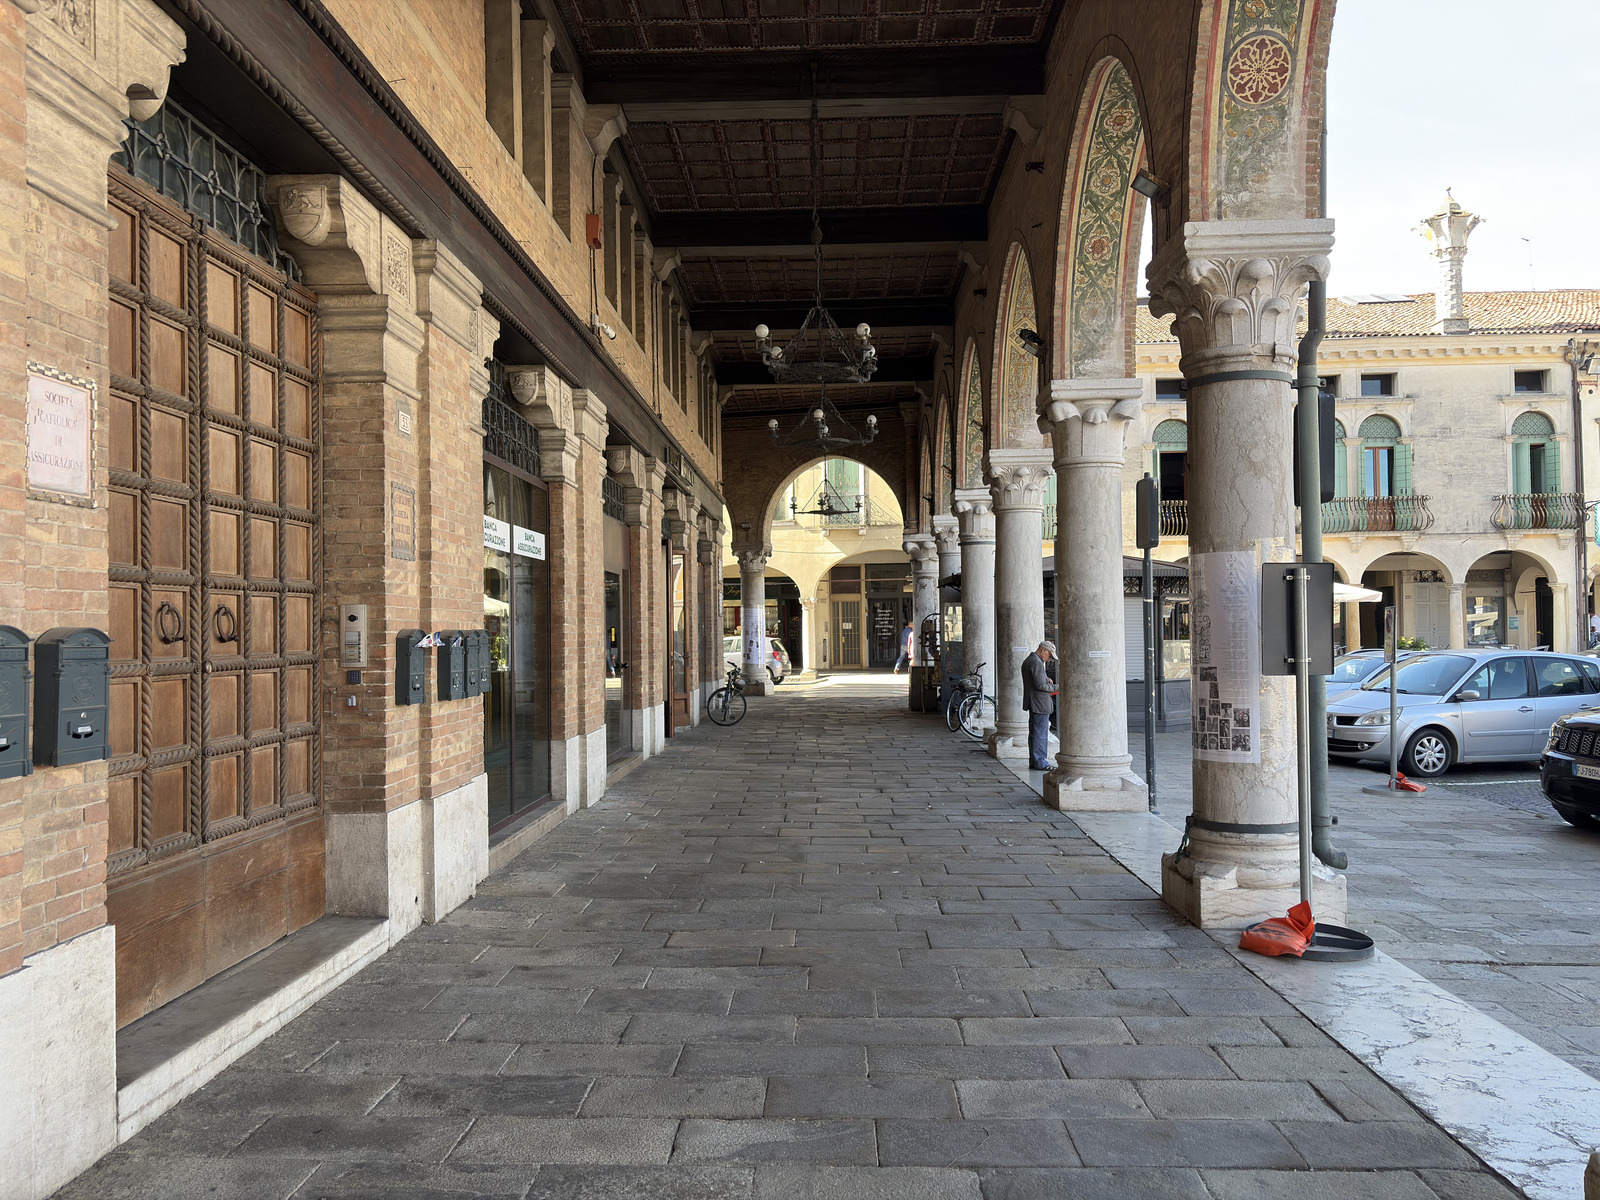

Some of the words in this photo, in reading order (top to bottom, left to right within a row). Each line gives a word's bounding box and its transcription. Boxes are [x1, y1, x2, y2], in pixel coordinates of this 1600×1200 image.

[54, 435, 63, 448] DI
[484, 519, 498, 533] BANCA
[524, 532, 536, 543] BANCA
